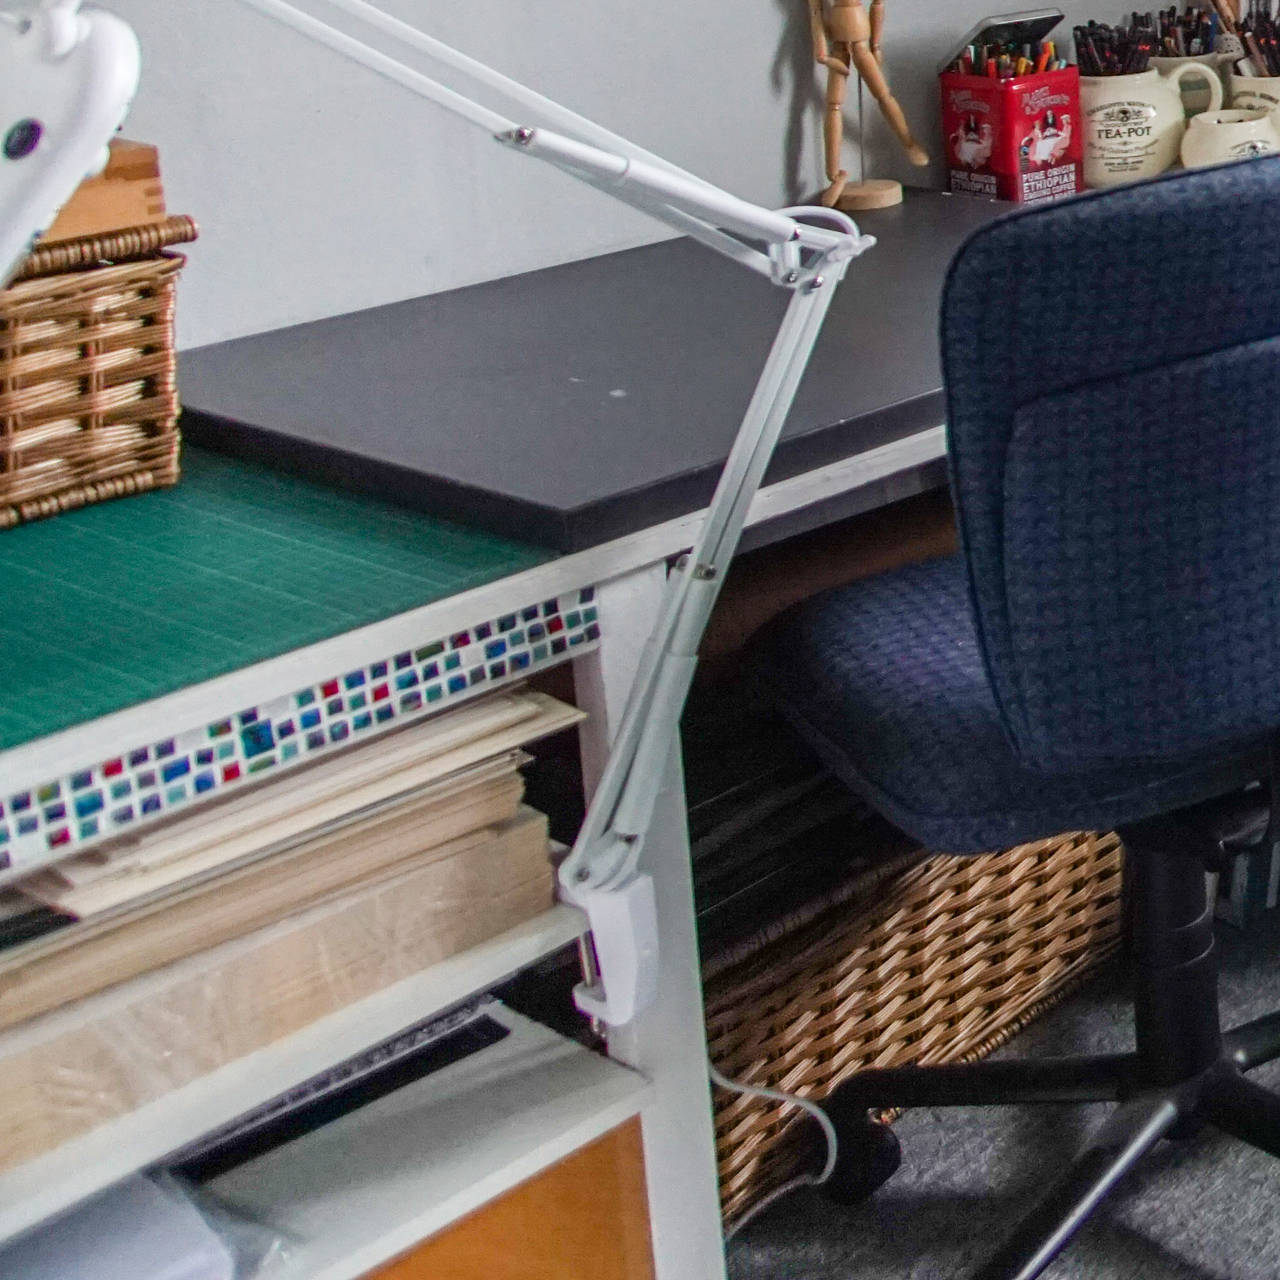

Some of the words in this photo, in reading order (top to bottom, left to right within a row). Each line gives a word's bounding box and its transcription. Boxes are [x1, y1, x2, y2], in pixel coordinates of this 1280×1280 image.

[1096, 126, 1153, 140] TEA-POT
[1022, 170, 1046, 183] PURE
[1046, 163, 1076, 178] ORIGIN
[1022, 172, 1076, 194] ETHIOPIAN
